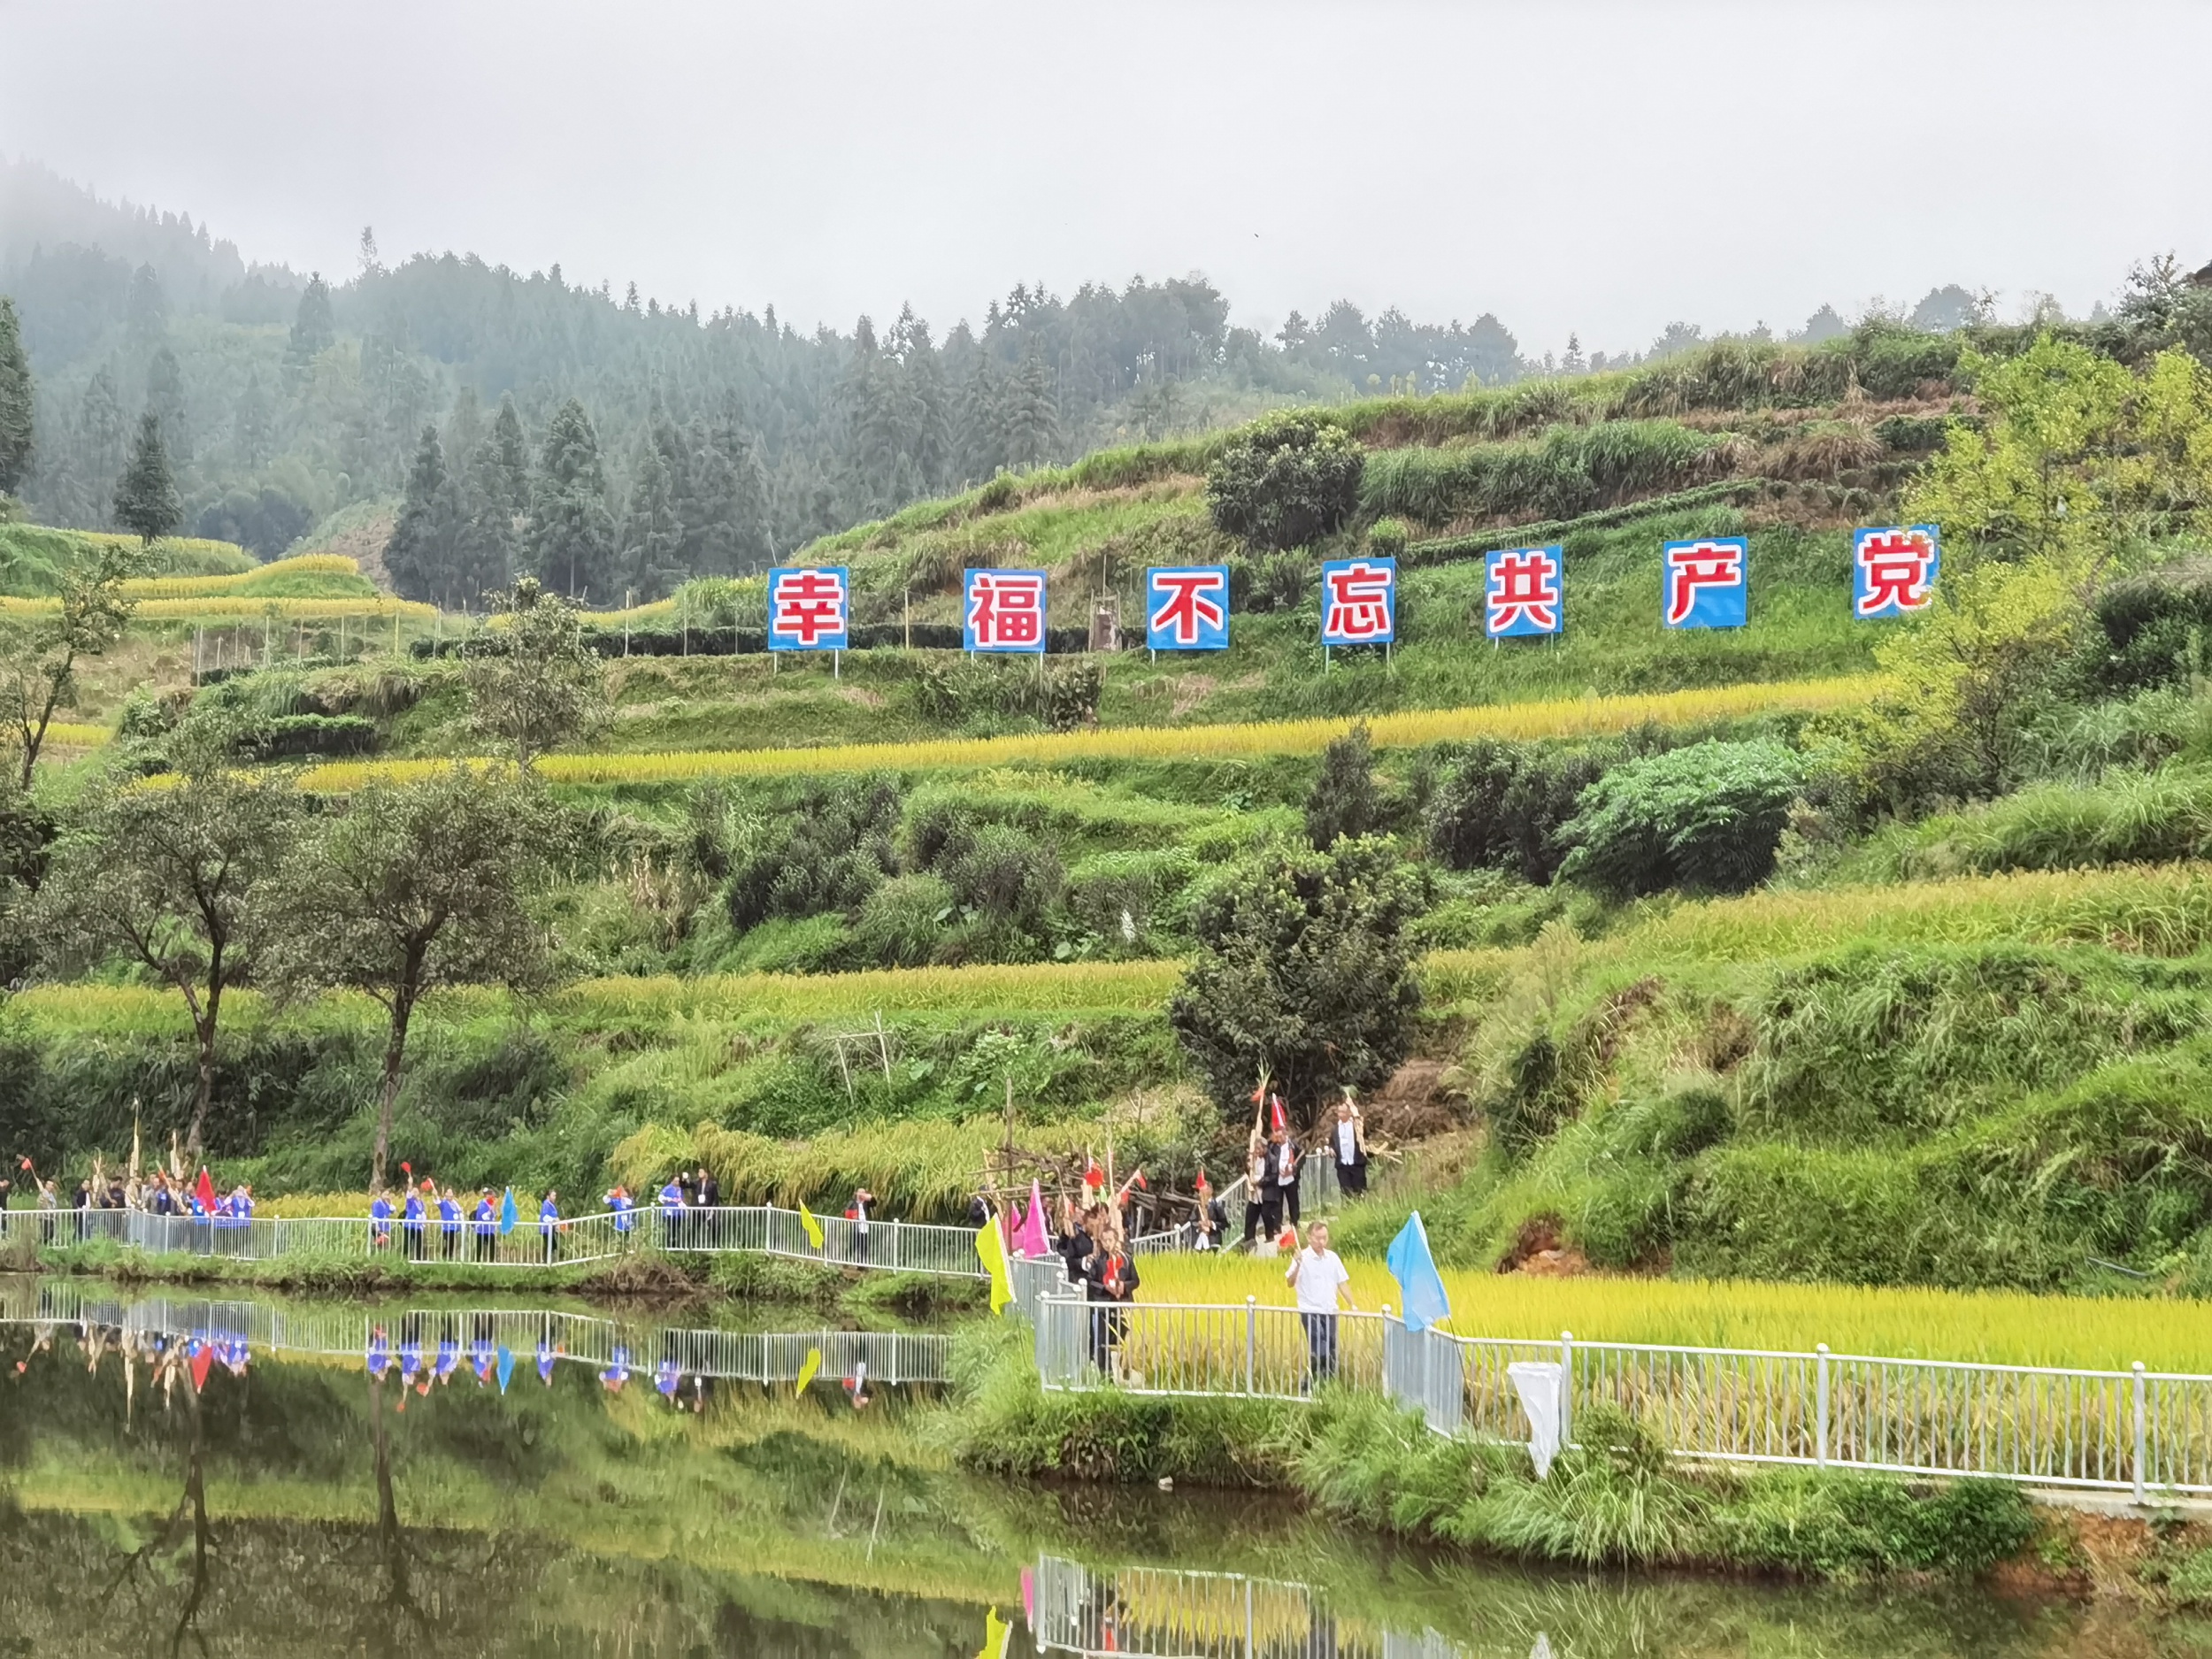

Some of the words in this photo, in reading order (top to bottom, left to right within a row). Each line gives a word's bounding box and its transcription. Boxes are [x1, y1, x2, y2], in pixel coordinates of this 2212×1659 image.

[773, 531, 1933, 646] 幸福不忘共产党
